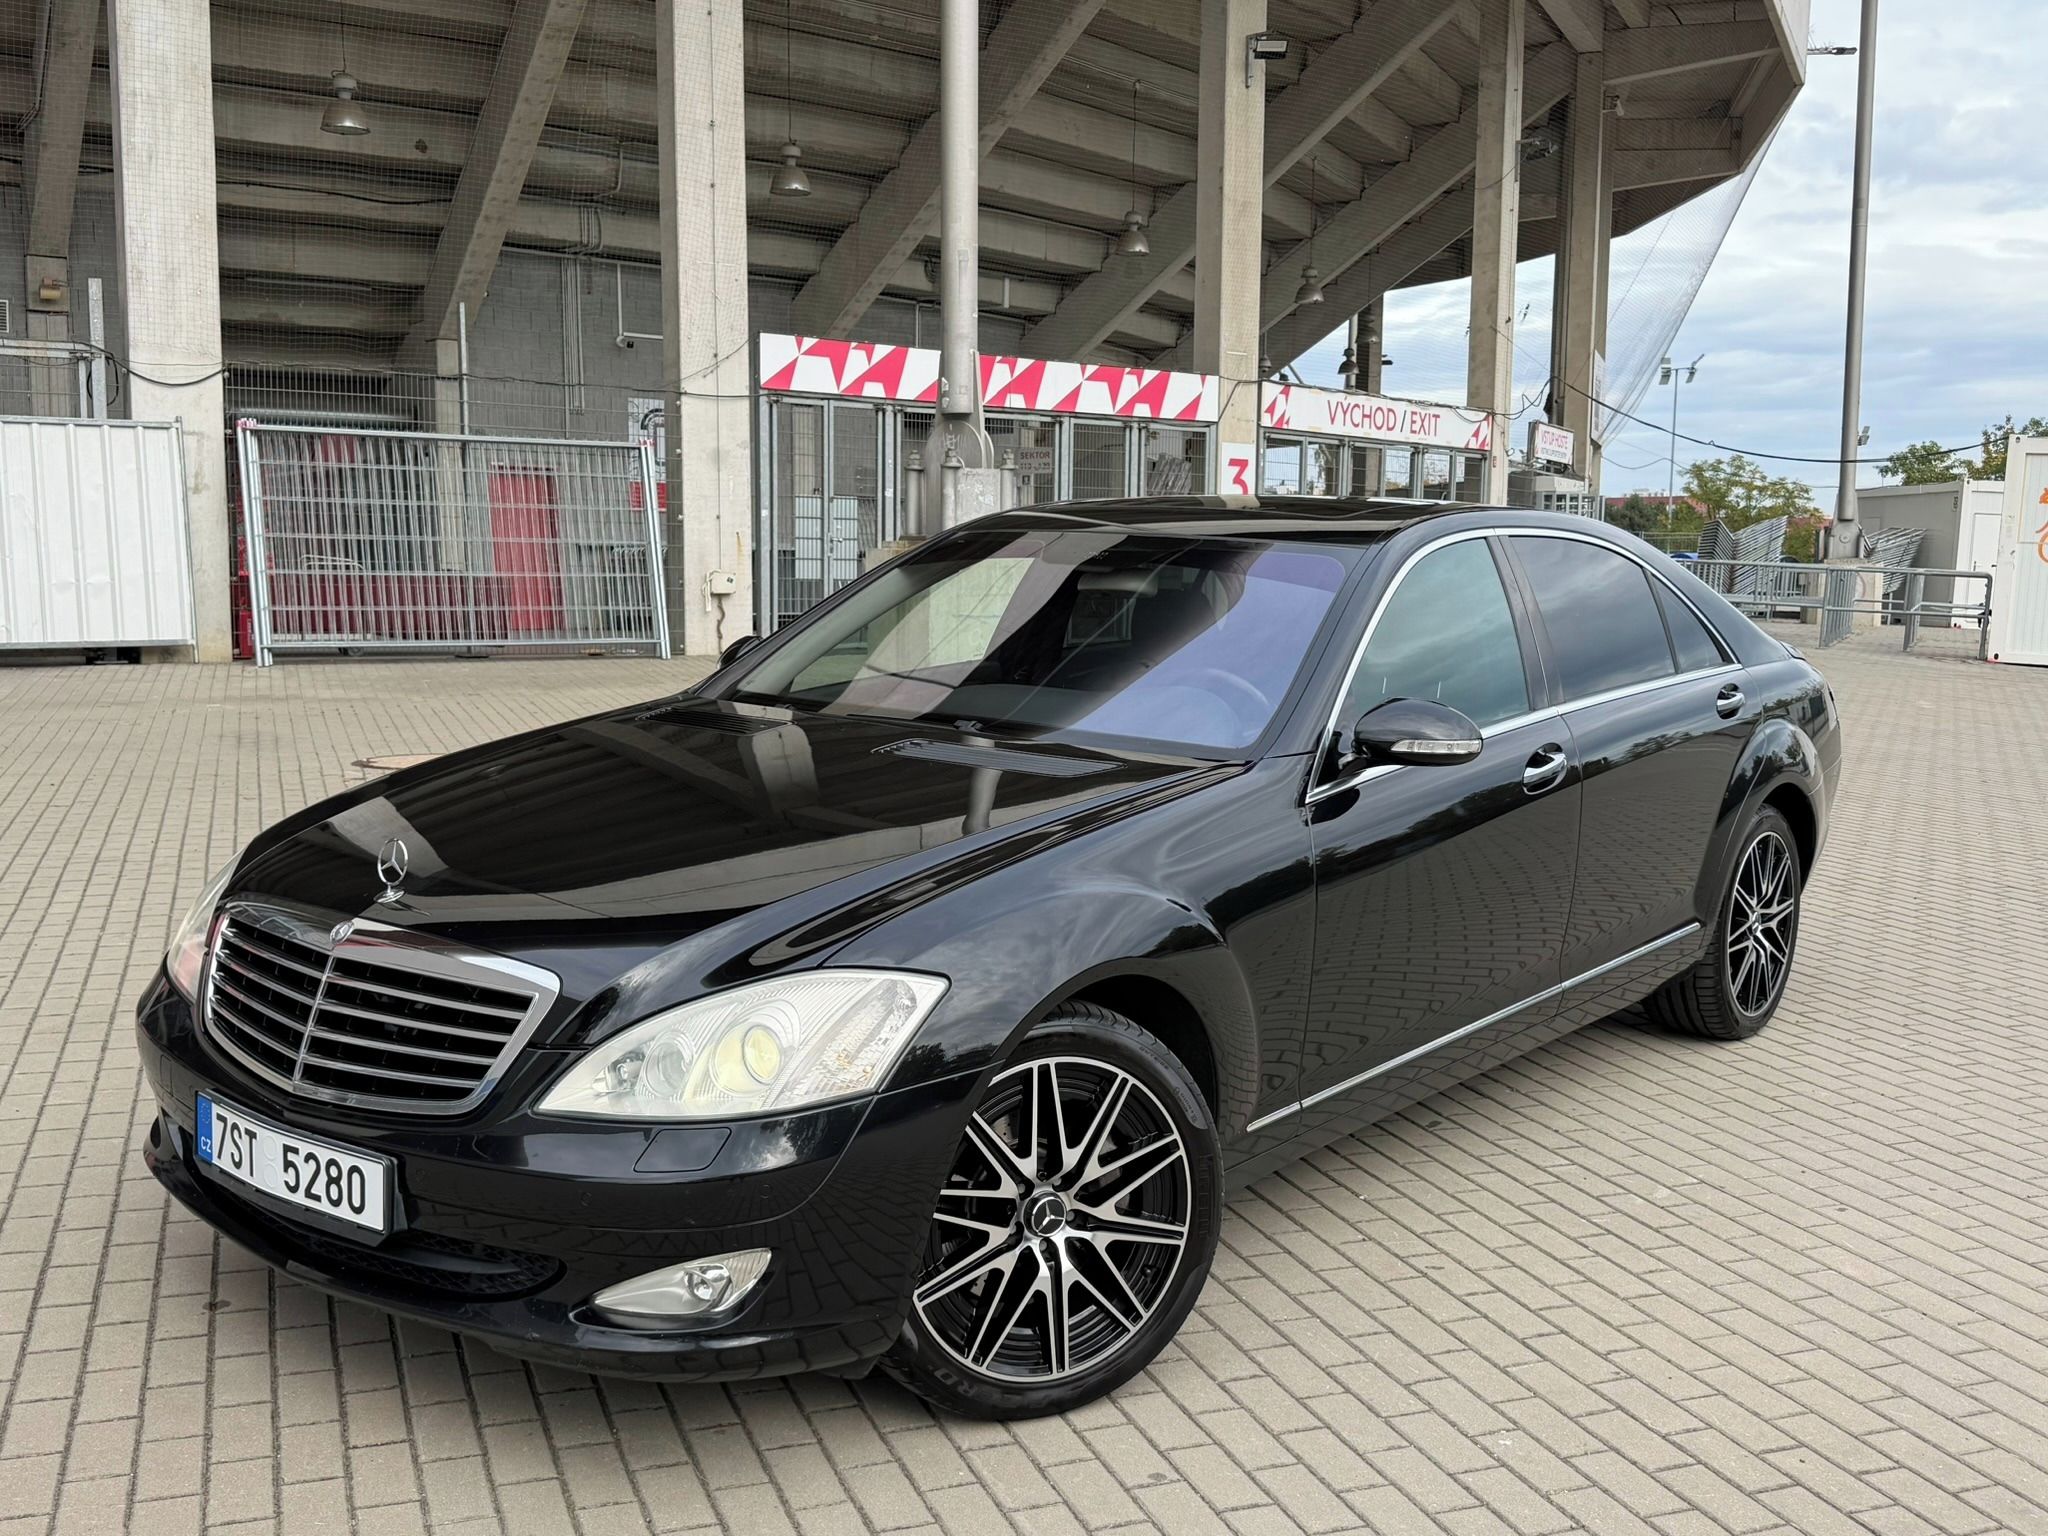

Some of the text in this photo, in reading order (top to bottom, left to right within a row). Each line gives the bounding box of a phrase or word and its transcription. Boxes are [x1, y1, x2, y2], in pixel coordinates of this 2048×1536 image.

[1327, 396, 1397, 432] VÝCHOD
[1410, 410, 1440, 437] EXIT
[1020, 451, 1050, 460] SEKTOR
[1228, 458, 1249, 496] 3
[200, 1136, 211, 1153] CZ
[216, 1111, 366, 1215] 7ST 5280
